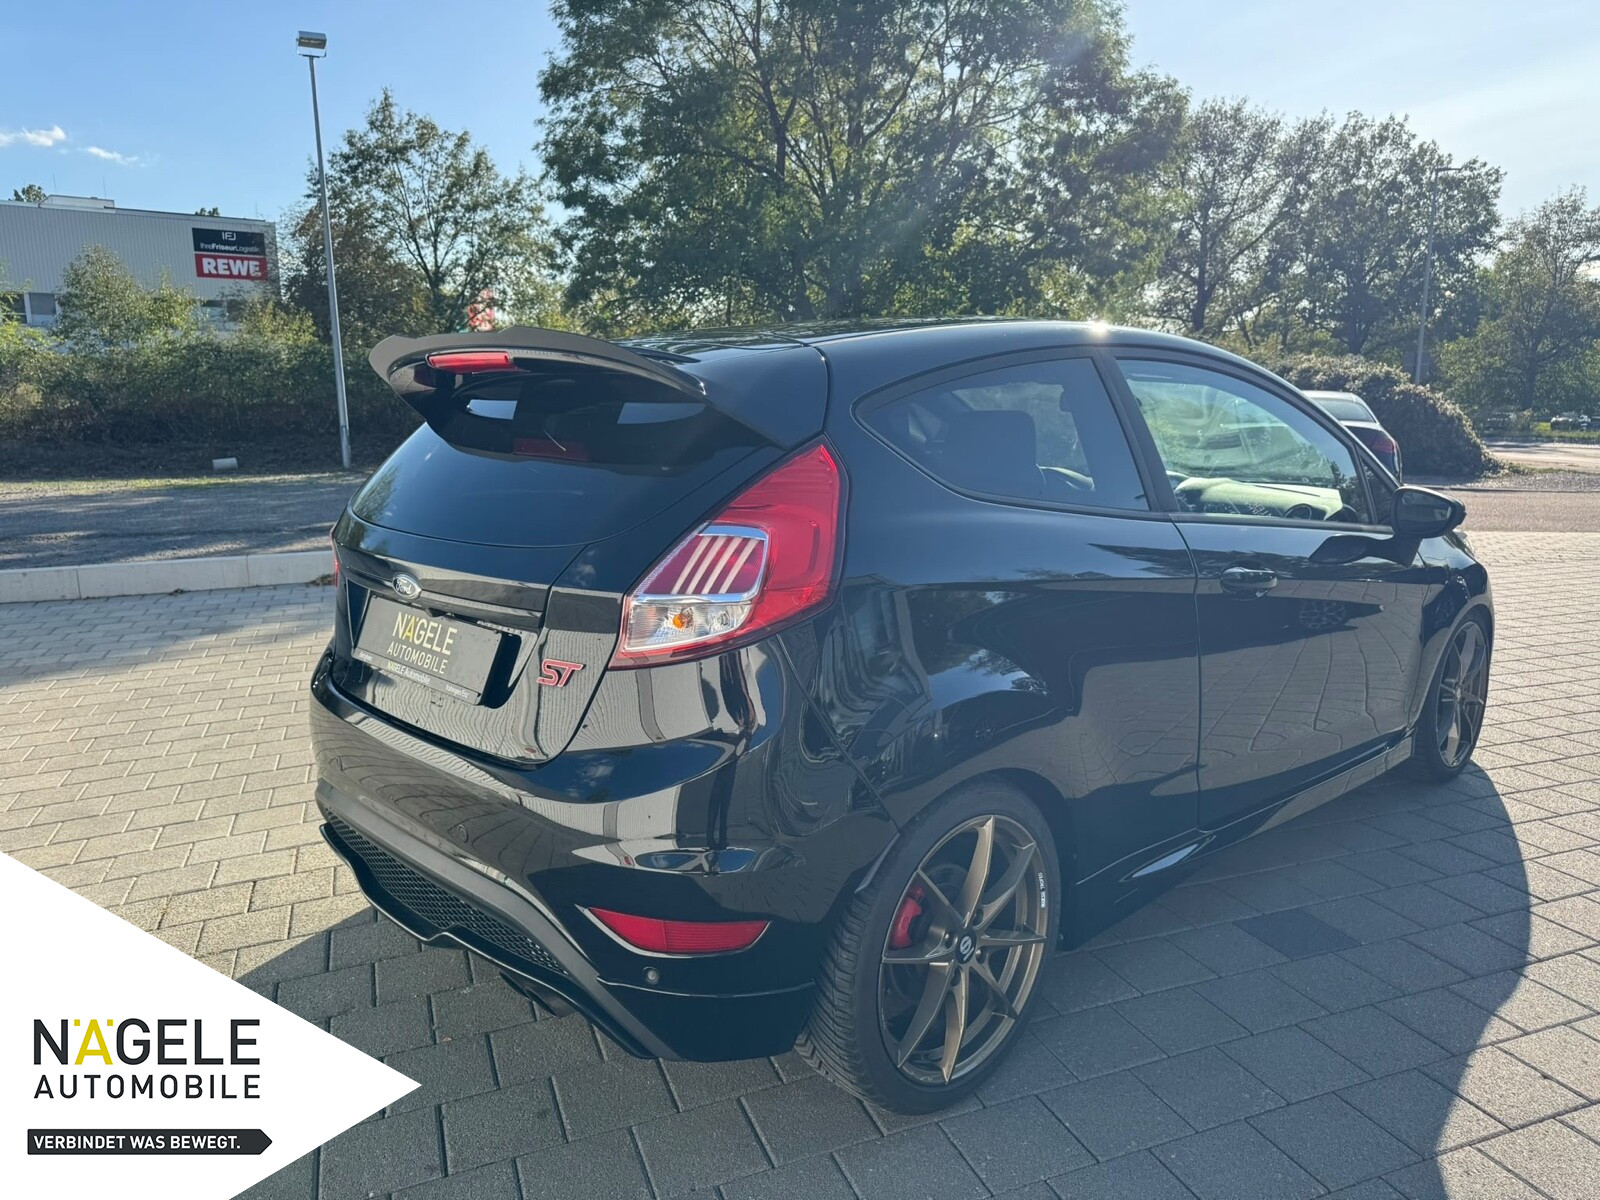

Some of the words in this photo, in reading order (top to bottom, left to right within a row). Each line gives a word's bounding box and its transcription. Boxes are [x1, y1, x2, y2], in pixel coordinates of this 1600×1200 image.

[202, 257, 262, 277] REWE
[392, 611, 458, 656] NÄGELE
[387, 641, 449, 675] AUTOMOBILE
[536, 658, 584, 688] ST
